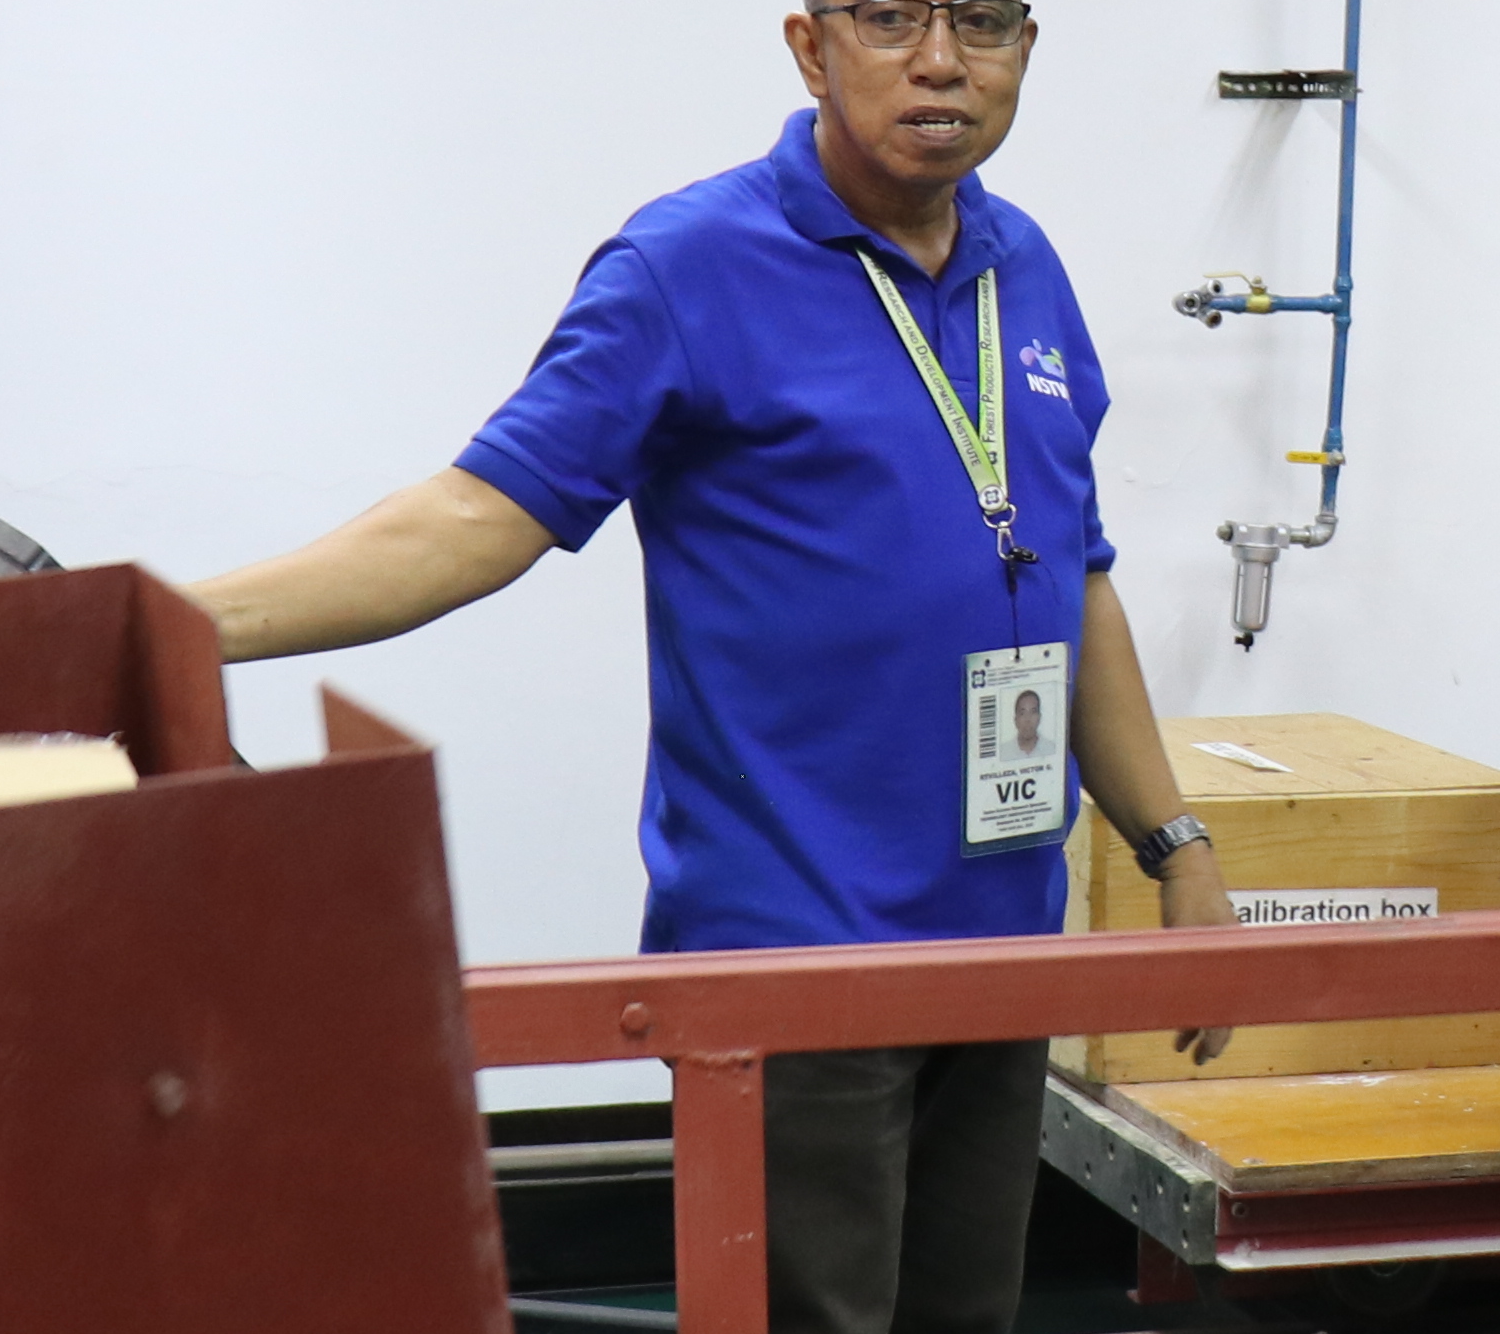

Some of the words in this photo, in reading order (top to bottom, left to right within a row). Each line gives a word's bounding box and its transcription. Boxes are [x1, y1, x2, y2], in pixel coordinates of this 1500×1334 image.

[996, 778, 1036, 804] VIC
[1237, 899, 1369, 924] alibration
[1381, 898, 1432, 918] box
